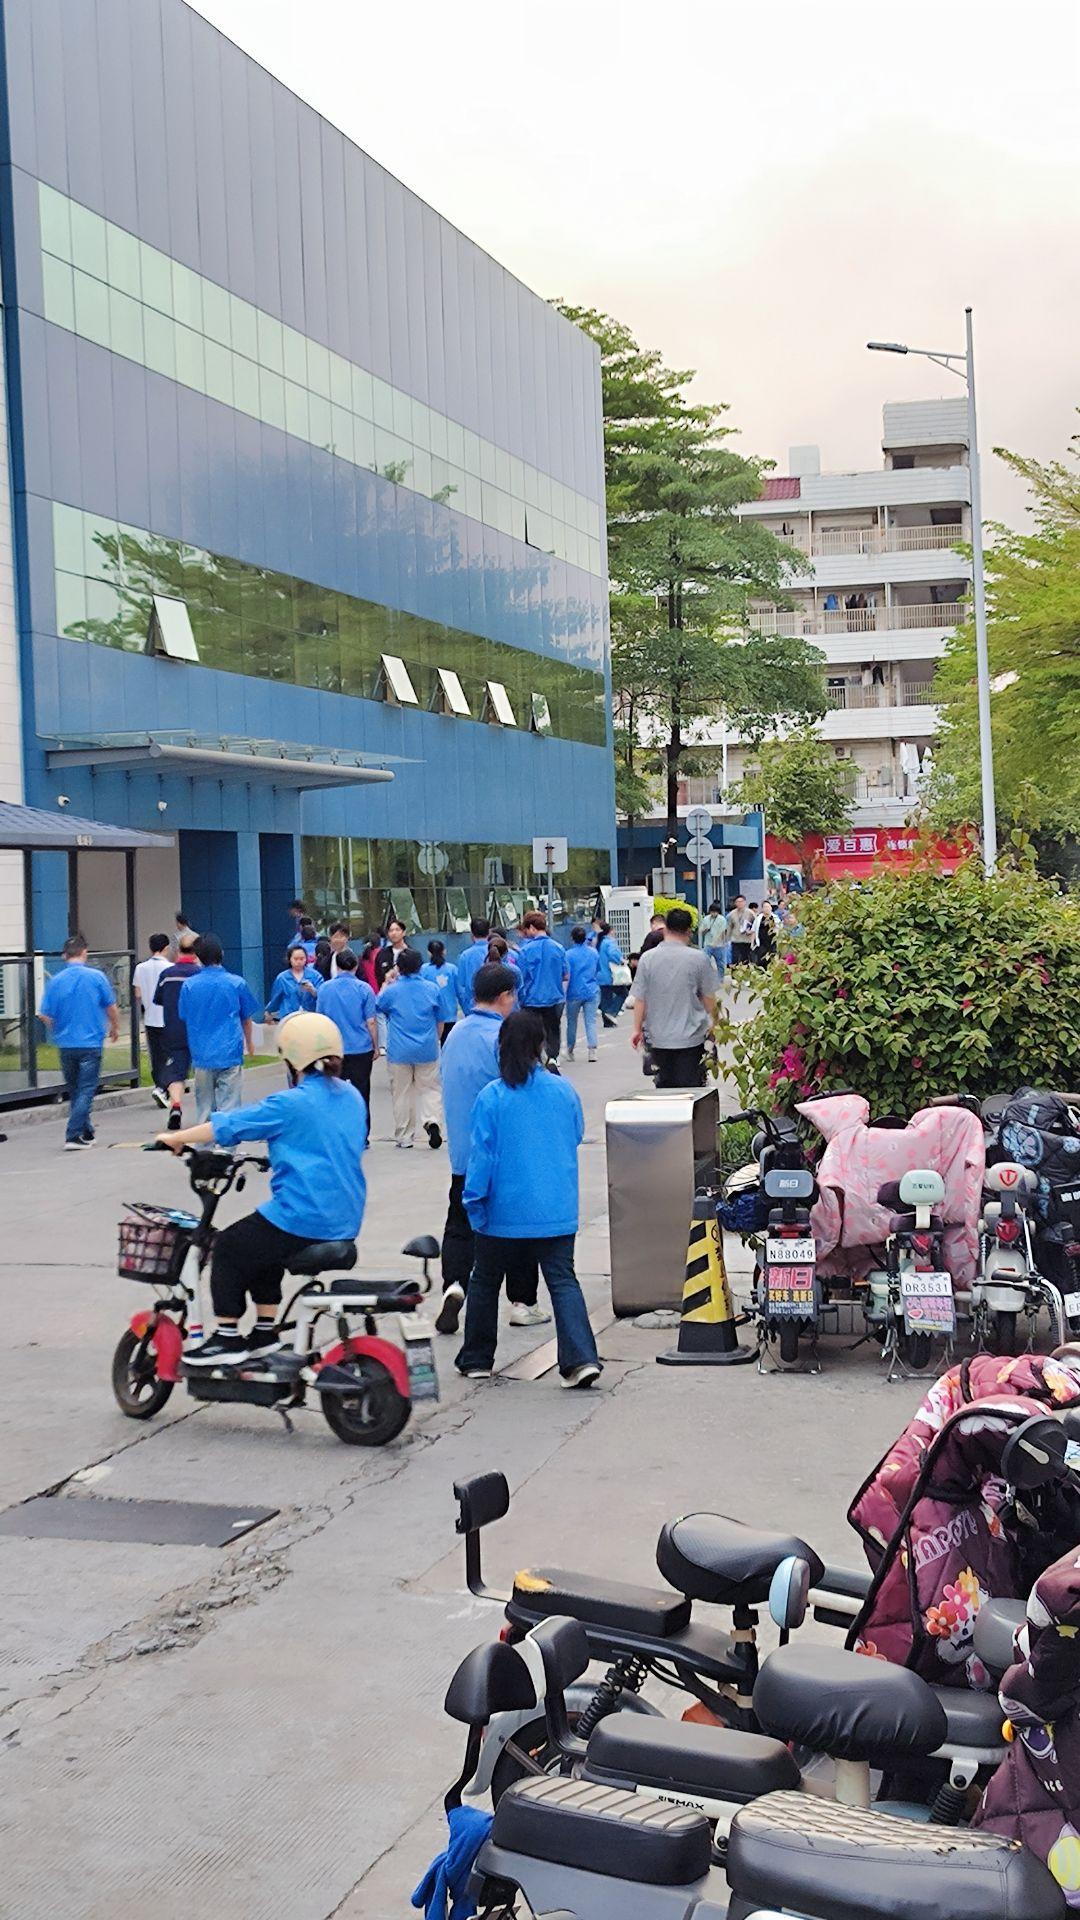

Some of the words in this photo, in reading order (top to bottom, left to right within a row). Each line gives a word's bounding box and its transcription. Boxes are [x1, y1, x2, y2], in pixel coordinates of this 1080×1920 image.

[827, 837, 874, 853] 爱百惠
[779, 1179, 798, 1188] 新日
[769, 1249, 813, 1260] N88049
[768, 1267, 813, 1290] 新日
